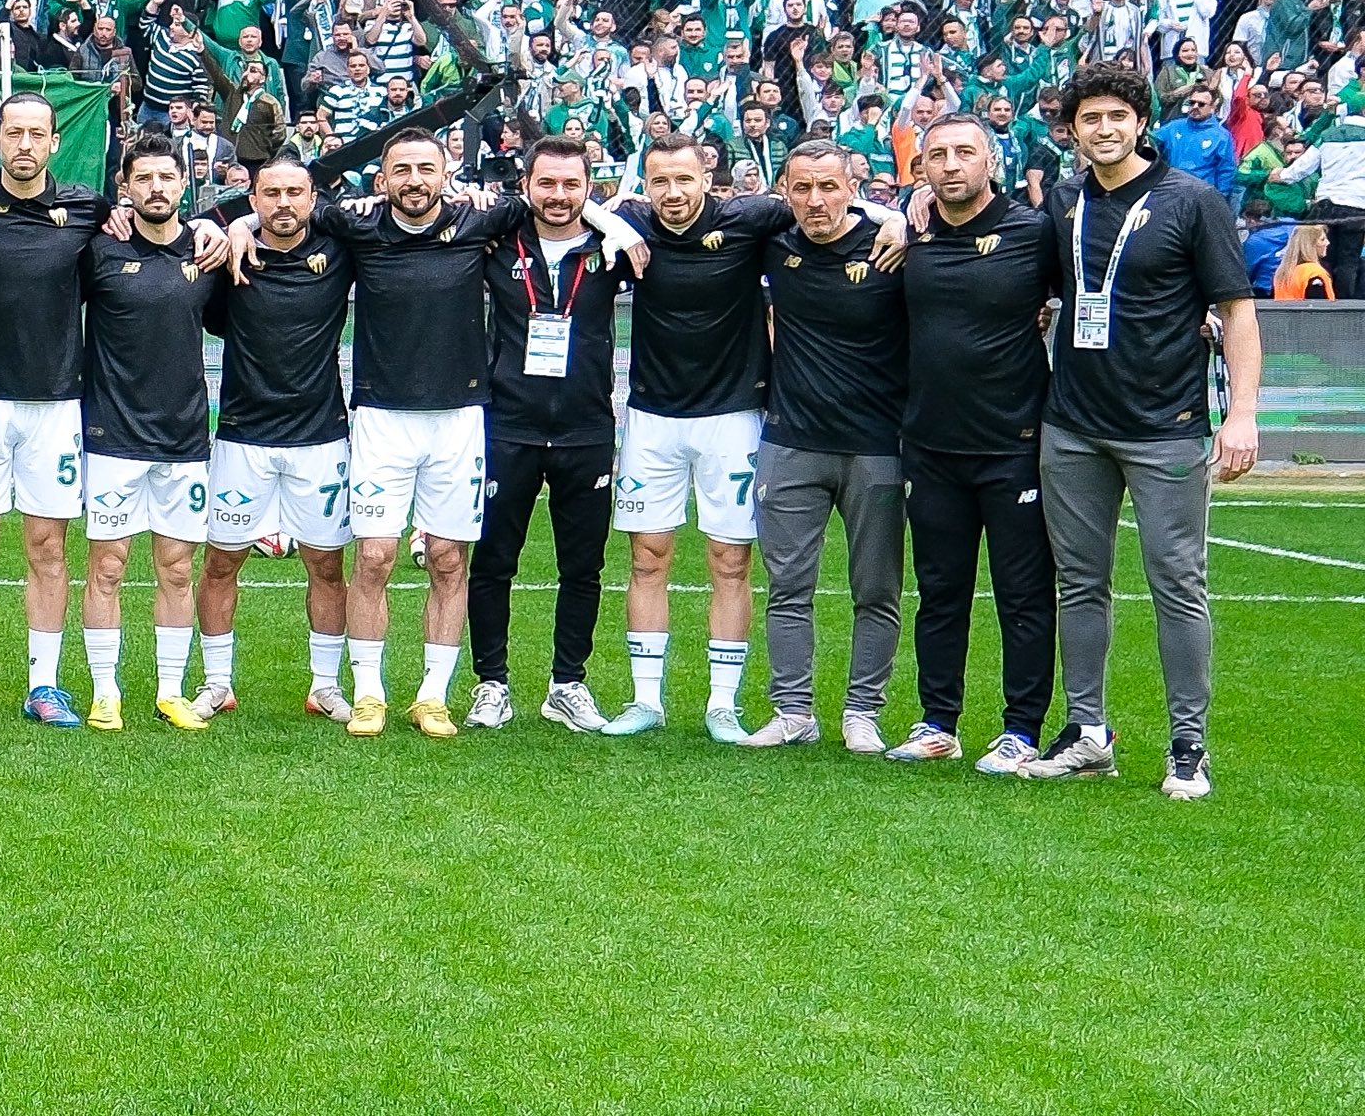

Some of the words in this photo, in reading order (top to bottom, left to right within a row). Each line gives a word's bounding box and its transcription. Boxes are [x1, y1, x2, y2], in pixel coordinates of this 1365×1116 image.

[189, 484, 205, 512] 9
[318, 478, 351, 517] 7
[729, 472, 752, 506] 7
[352, 501, 385, 518] Togg
[616, 497, 645, 514] ogg
[91, 508, 128, 526] Togg
[214, 506, 251, 525] Togg
